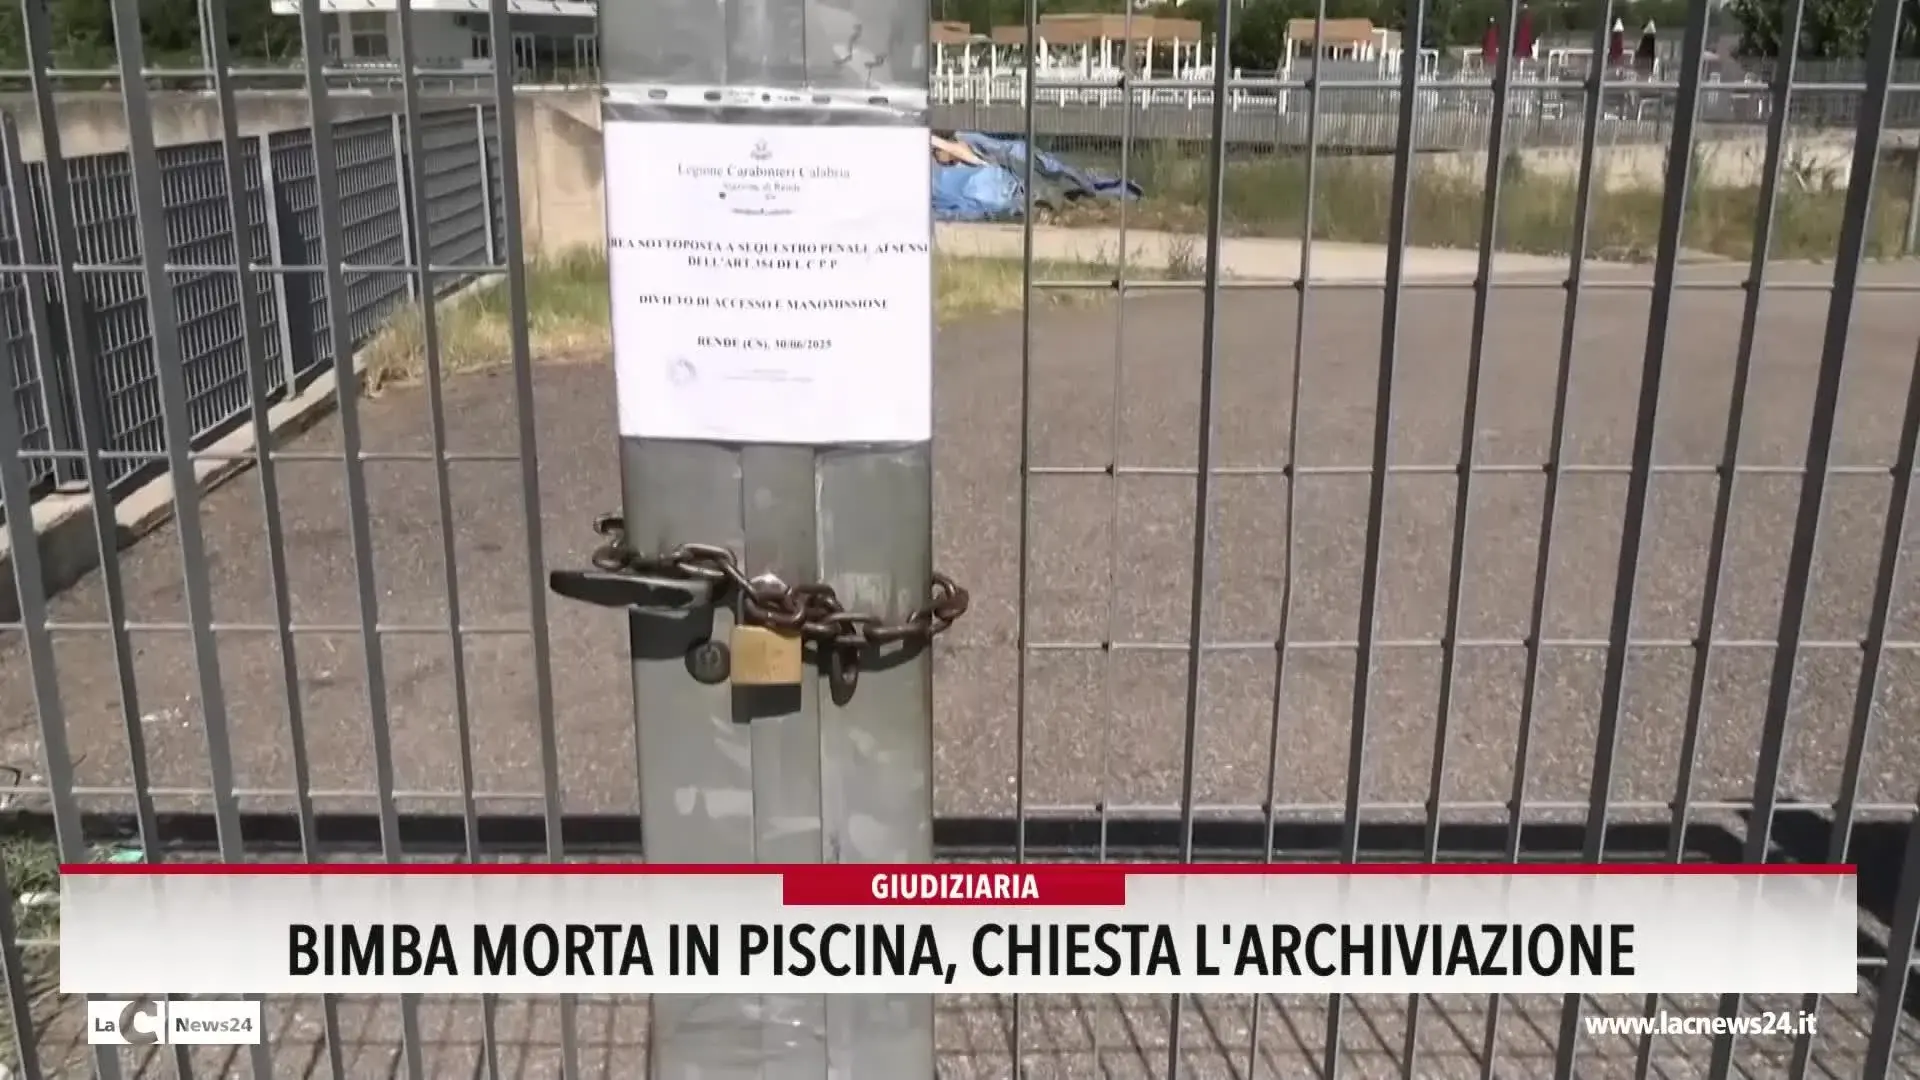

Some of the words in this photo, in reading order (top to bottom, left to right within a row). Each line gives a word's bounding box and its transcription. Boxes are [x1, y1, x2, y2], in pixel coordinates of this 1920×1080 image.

[609, 237, 635, 248] REA
[638, 238, 722, 252] SOTTOPOSTA
[738, 242, 817, 255] SEQUESTRO
[820, 243, 869, 254] PENALE
[639, 295, 693, 305] DIVIETO
[714, 297, 772, 310] ACCESSO
[787, 300, 888, 311] MANOMISSIONE
